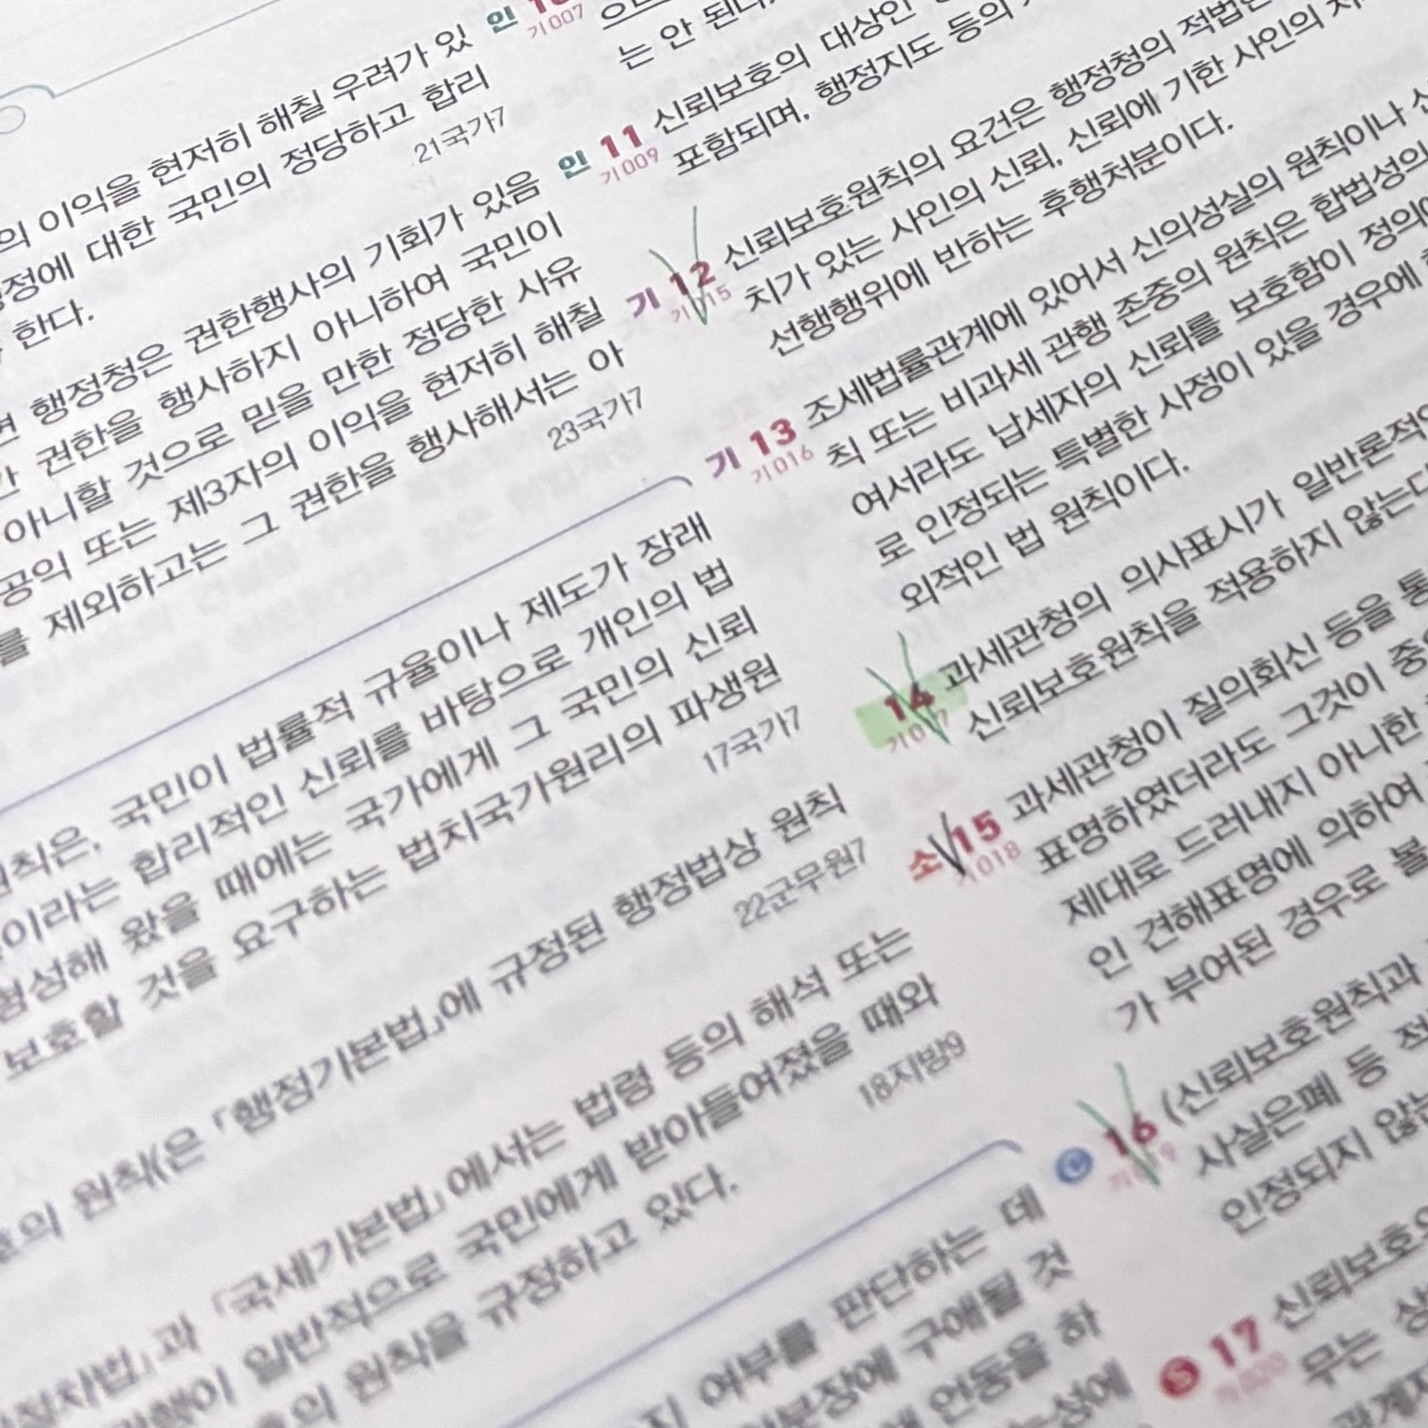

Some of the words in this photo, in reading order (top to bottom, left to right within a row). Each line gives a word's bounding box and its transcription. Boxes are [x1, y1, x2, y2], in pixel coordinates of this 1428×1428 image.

[486, 5, 519, 34] 인
[557, 149, 592, 180] 인
[599, 124, 643, 159] 11
[654, 42, 812, 135] 신뢰보호의
[618, 43, 655, 71] 는
[659, 17, 696, 51] 안
[672, 97, 810, 176] 포함되며,
[814, 32, 944, 107] 행정지도
[38, 173, 142, 233] 이익을
[147, 122, 252, 187] 현저히
[256, 88, 328, 135] 해칠
[332, 42, 429, 102] 우려가
[434, 23, 474, 58] 있
[85, 215, 157, 262] 대한
[167, 162, 272, 225] 국민의
[279, 102, 415, 176] 정당하고
[421, 63, 490, 112] 합리
[413, 105, 504, 164] 21국가7
[625, 286, 661, 319] 기
[723, 144, 946, 272] 신뢰보호원칙의
[950, 97, 1046, 160] 요건은
[1048, 29, 1177, 108] 행정청의
[744, 262, 812, 313] 치가
[814, 234, 884, 280] 있는
[891, 176, 987, 243] 사인의
[990, 141, 1064, 193] 신뢰,
[1067, 88, 1163, 154] 신뢰에
[1162, 54, 1229, 102] 기한
[1234, 3, 1325, 68] 사인의
[769, 257, 931, 357] 선행행위에
[932, 213, 1034, 274] 반하는
[1038, 109, 1234, 218] 후행처분이다.
[5, 475, 114, 543] 아니할
[123, 421, 235, 491] 것으로
[240, 382, 314, 435] 믿을
[321, 342, 395, 396] 만한
[402, 289, 507, 357] 정당한
[518, 255, 582, 304] 사유
[12, 298, 94, 351] 한다.
[29, 343, 173, 426] 행정청은
[183, 255, 356, 355] 권한행사의
[363, 204, 465, 268] 기회가
[472, 170, 541, 220] 있음
[36, 408, 144, 478] 권한을
[157, 333, 301, 420] 행사하지
[312, 263, 450, 343] 아니하여
[460, 210, 563, 273] 국민이
[937, 581, 1112, 692] 과세관청의
[1120, 489, 1286, 595] 의사표시가
[968, 597, 1202, 742] 신뢰보호원칙을
[1204, 518, 1344, 605] 적용하지
[1005, 708, 1183, 823] 과세관청이
[1182, 631, 1323, 727] 질의회신
[1323, 593, 1397, 650] 등을
